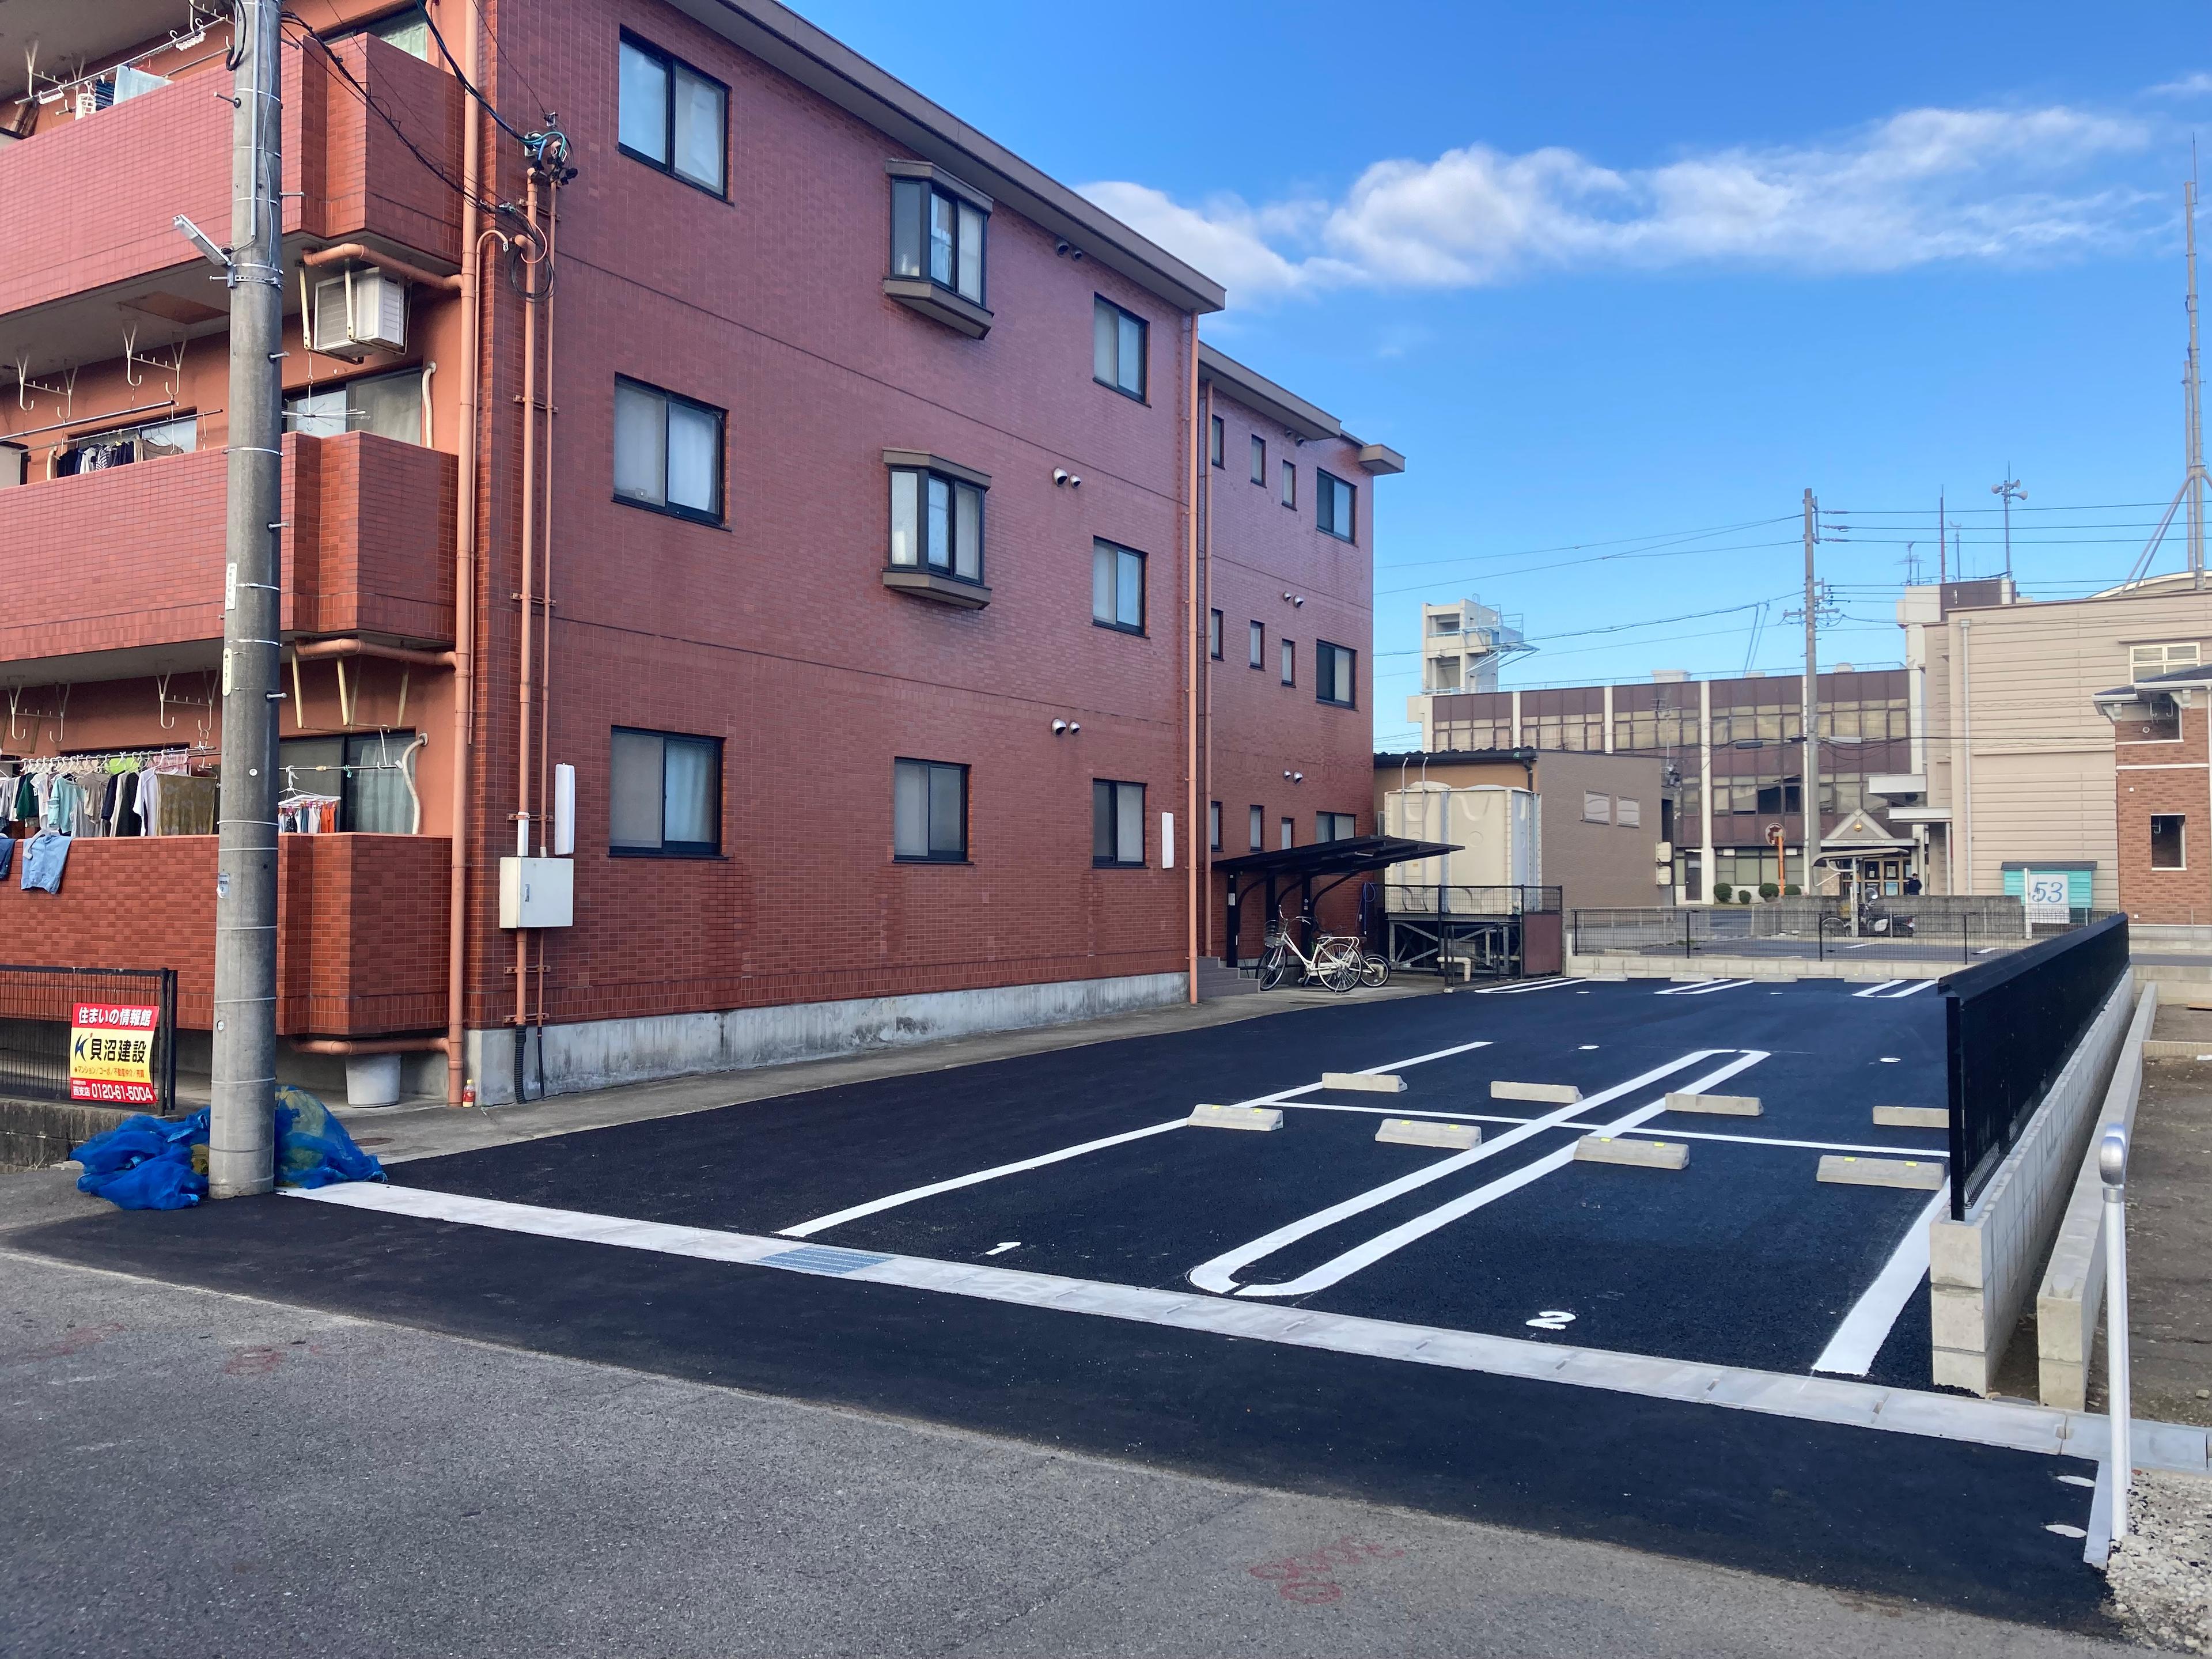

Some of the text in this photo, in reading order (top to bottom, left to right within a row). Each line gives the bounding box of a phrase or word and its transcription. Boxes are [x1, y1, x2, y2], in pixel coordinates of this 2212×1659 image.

[2032, 882, 2063, 903] 53
[78, 1006, 153, 1027] 住まいの情報館
[90, 1038, 146, 1063] 貝沼建設
[91, 1082, 154, 1102] 0120-61-5004
[1525, 1310, 1576, 1330] 2
